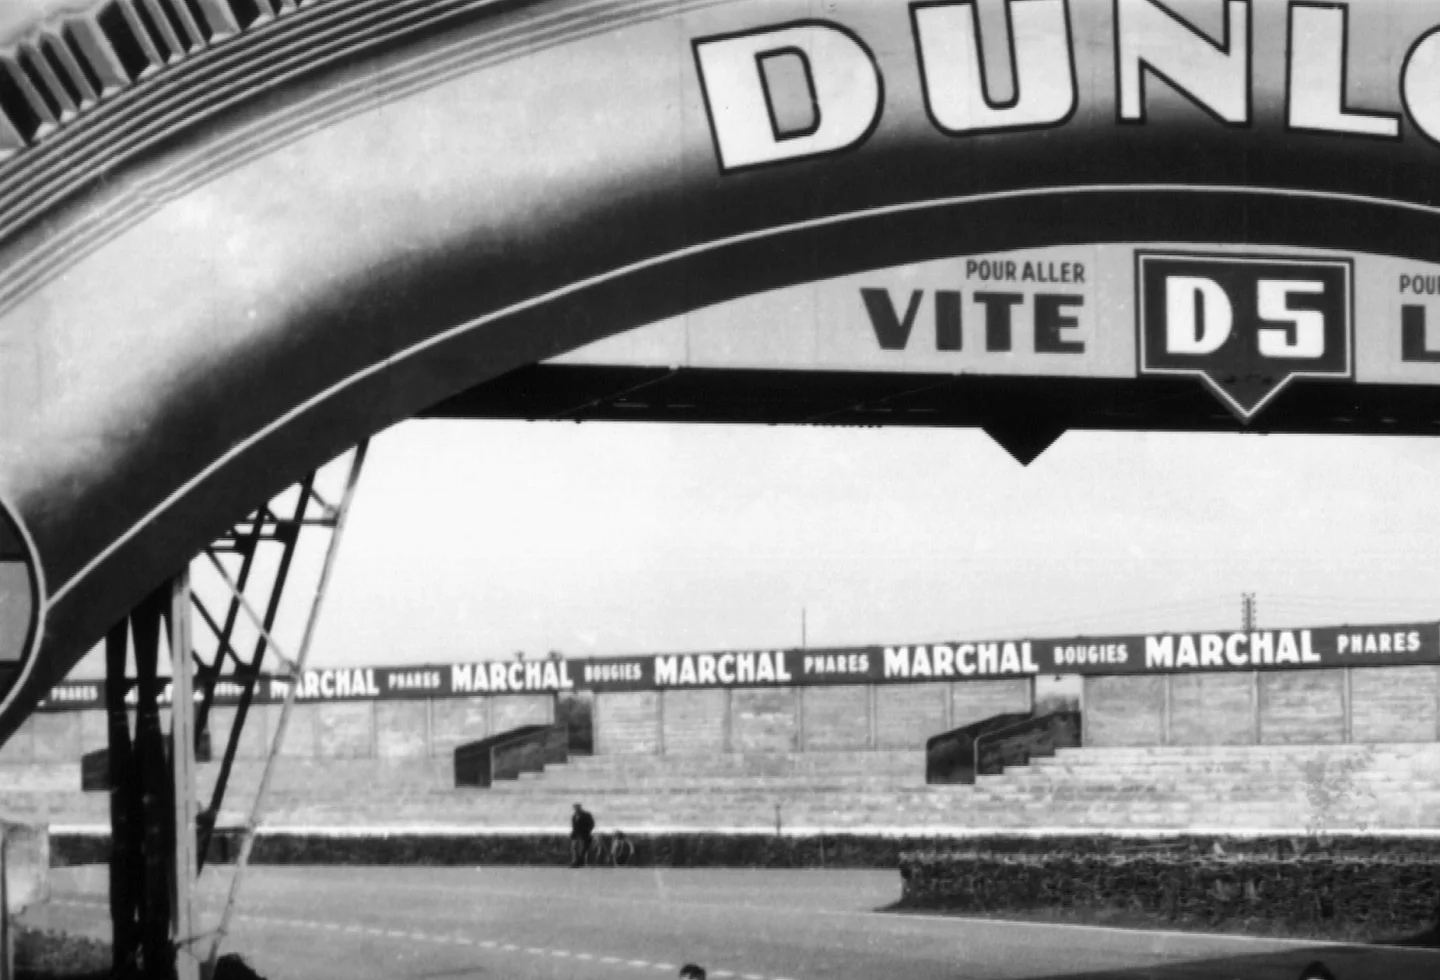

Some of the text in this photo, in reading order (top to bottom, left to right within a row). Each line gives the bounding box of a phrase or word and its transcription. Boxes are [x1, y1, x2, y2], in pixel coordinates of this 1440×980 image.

[966, 259, 1085, 283] POUR ALLER
[860, 288, 1085, 354] VITE
[388, 671, 441, 690] PHARES
[451, 661, 573, 693] MARCHAL
[584, 662, 642, 683] BOUGIES
[654, 652, 791, 685] MARCHAL
[804, 654, 870, 674] PHARES
[883, 641, 1038, 677] MARCHAL
[1053, 644, 1129, 666] BOUGIES
[1144, 632, 1321, 668] MARCHAL
[1336, 631, 1421, 654] PHARES
